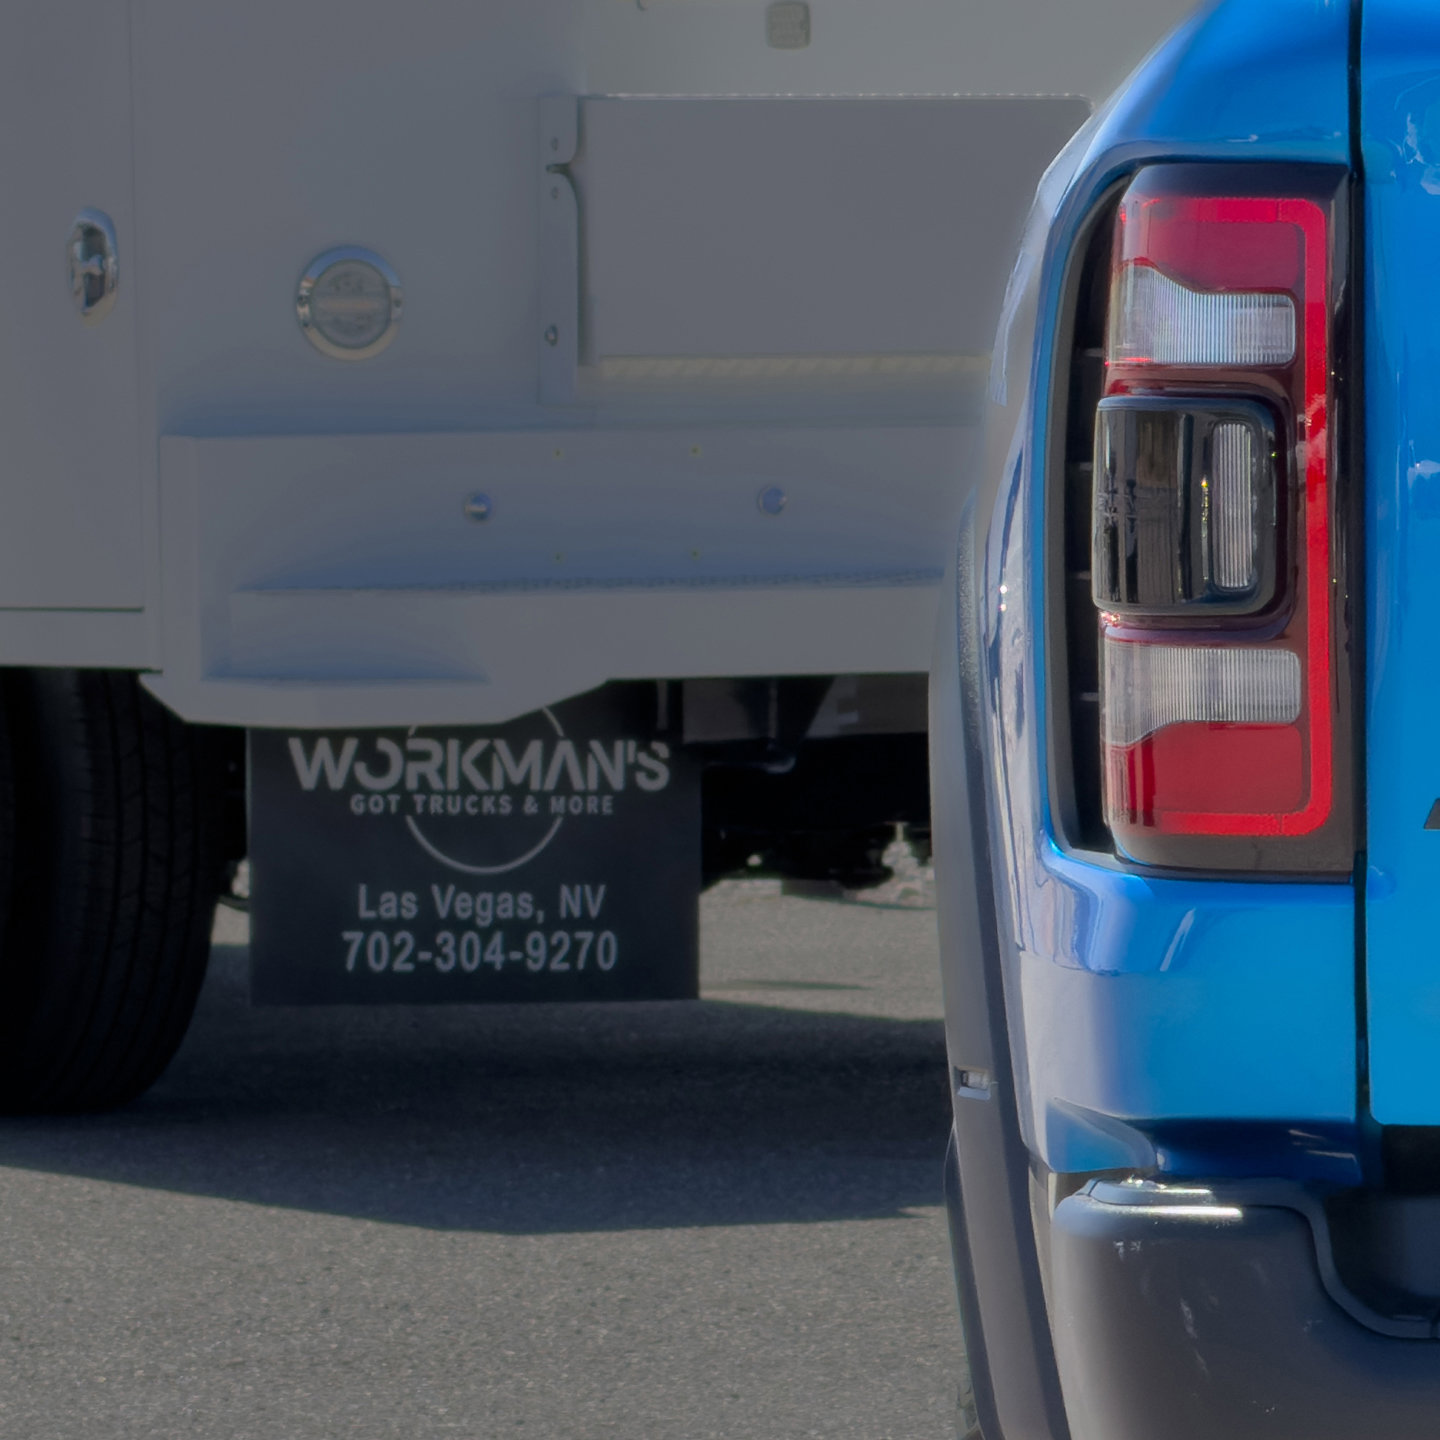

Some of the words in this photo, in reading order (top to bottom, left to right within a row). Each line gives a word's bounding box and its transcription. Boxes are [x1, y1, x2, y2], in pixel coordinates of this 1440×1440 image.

[288, 736, 670, 791] WORKMAN'S
[350, 794, 400, 815] GOT
[412, 794, 512, 815] TRUCKS
[523, 794, 539, 815] &
[551, 794, 614, 816] MORE
[357, 884, 417, 919] Las
[432, 884, 545, 928] Vegas,
[560, 885, 606, 919] NV
[341, 930, 618, 973] 702-304-9270
